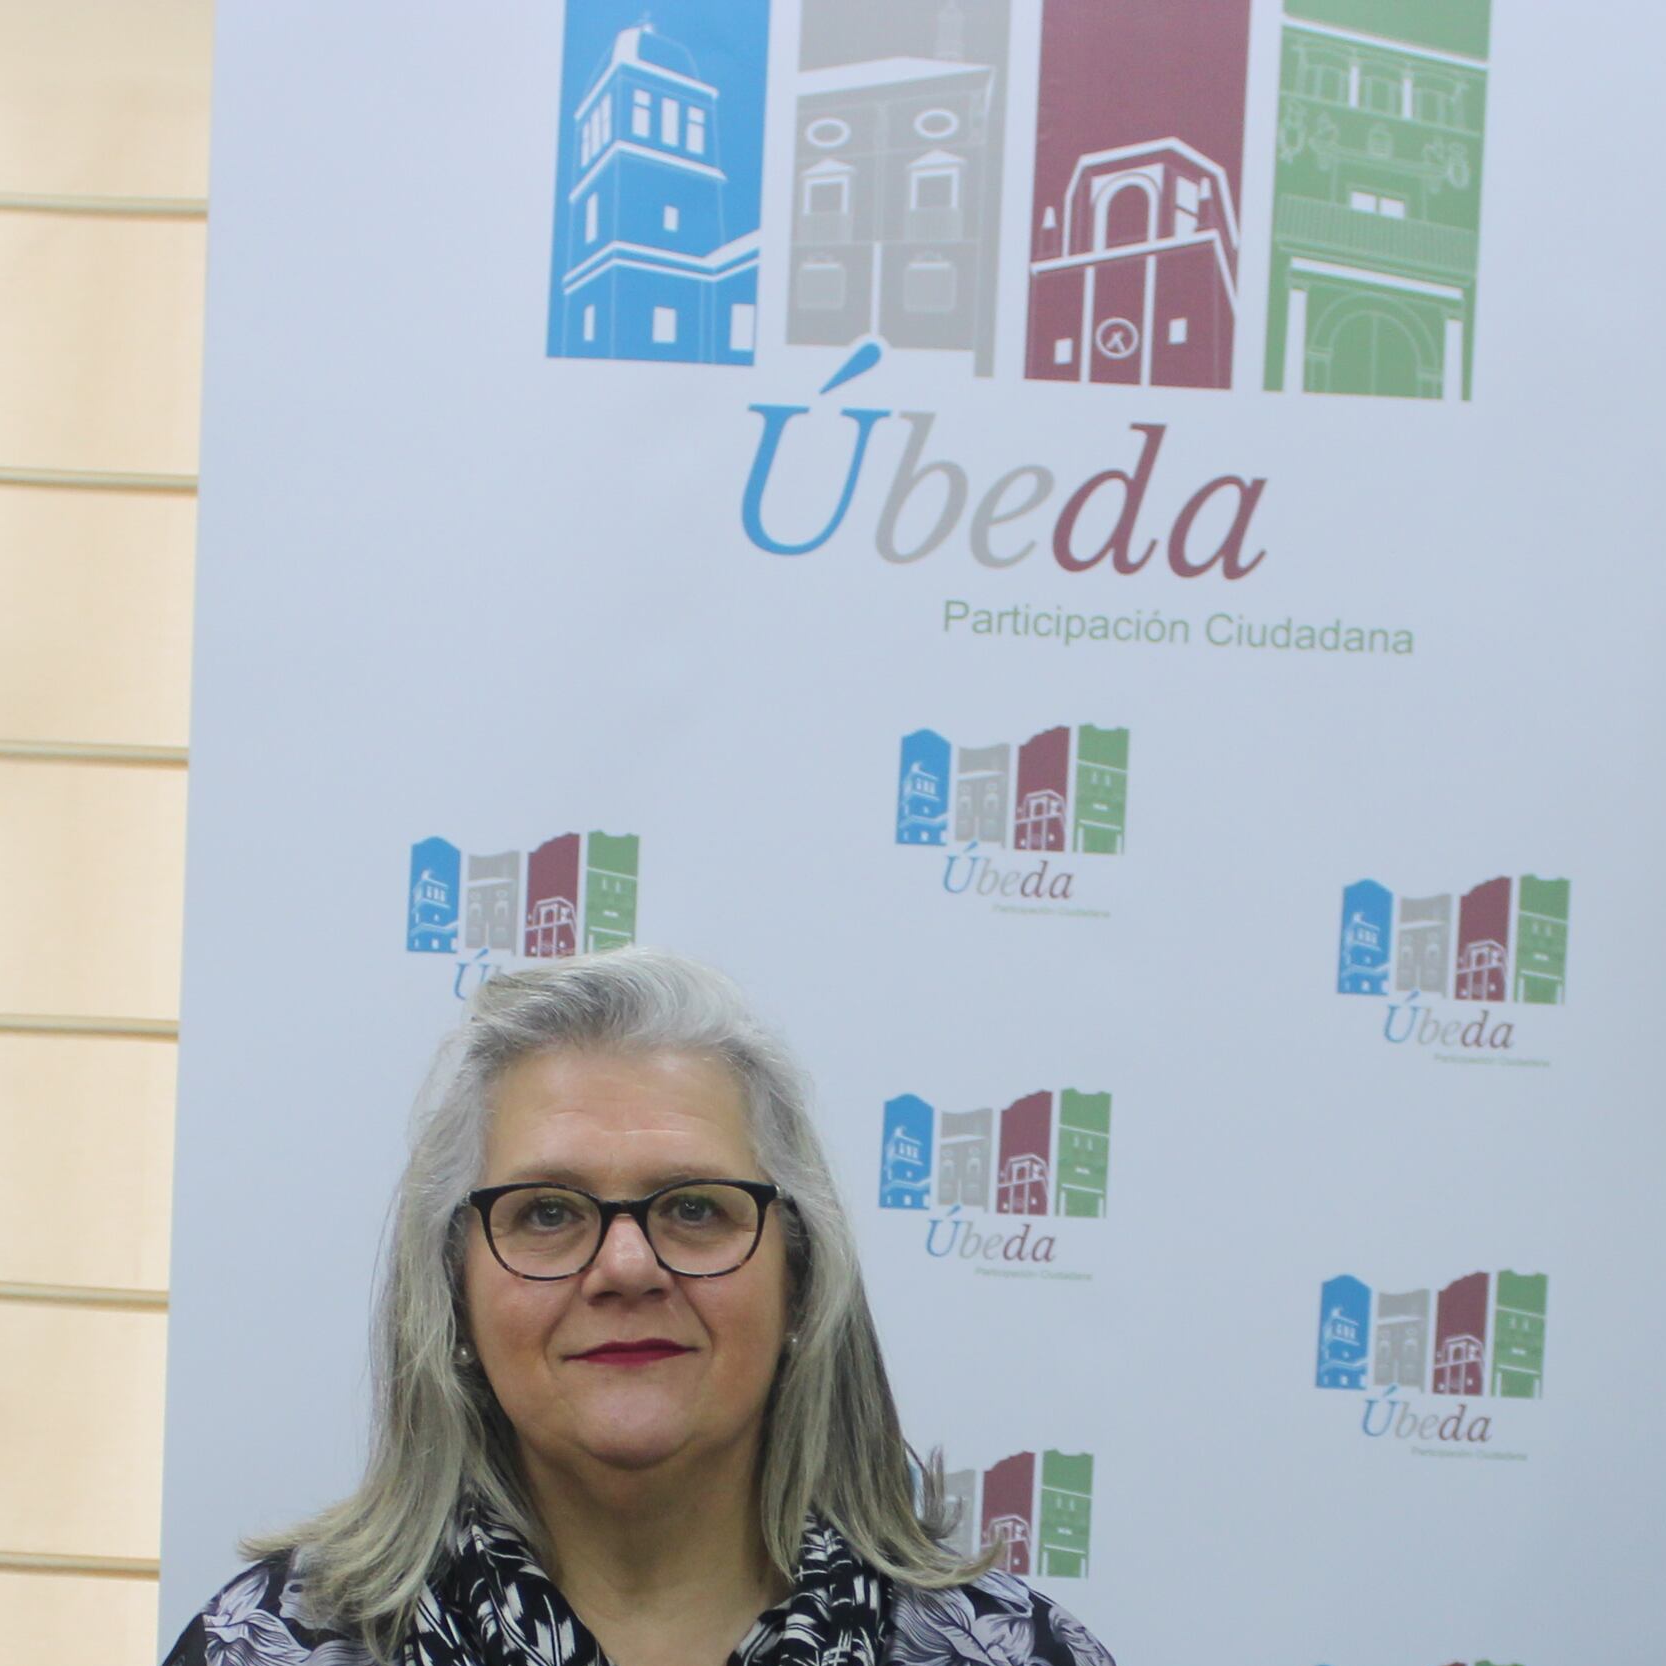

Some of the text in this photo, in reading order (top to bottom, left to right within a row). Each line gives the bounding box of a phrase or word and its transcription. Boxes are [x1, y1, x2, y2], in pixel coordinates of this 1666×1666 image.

[742, 342, 1268, 580] Úbeda
[943, 599, 1415, 656] Participación Ciudadana
[943, 842, 1074, 899] Úbeda
[1384, 990, 1514, 1049] Úbeda
[926, 1205, 1055, 1262] Úbeda
[1362, 1385, 1491, 1442] Úbeda
